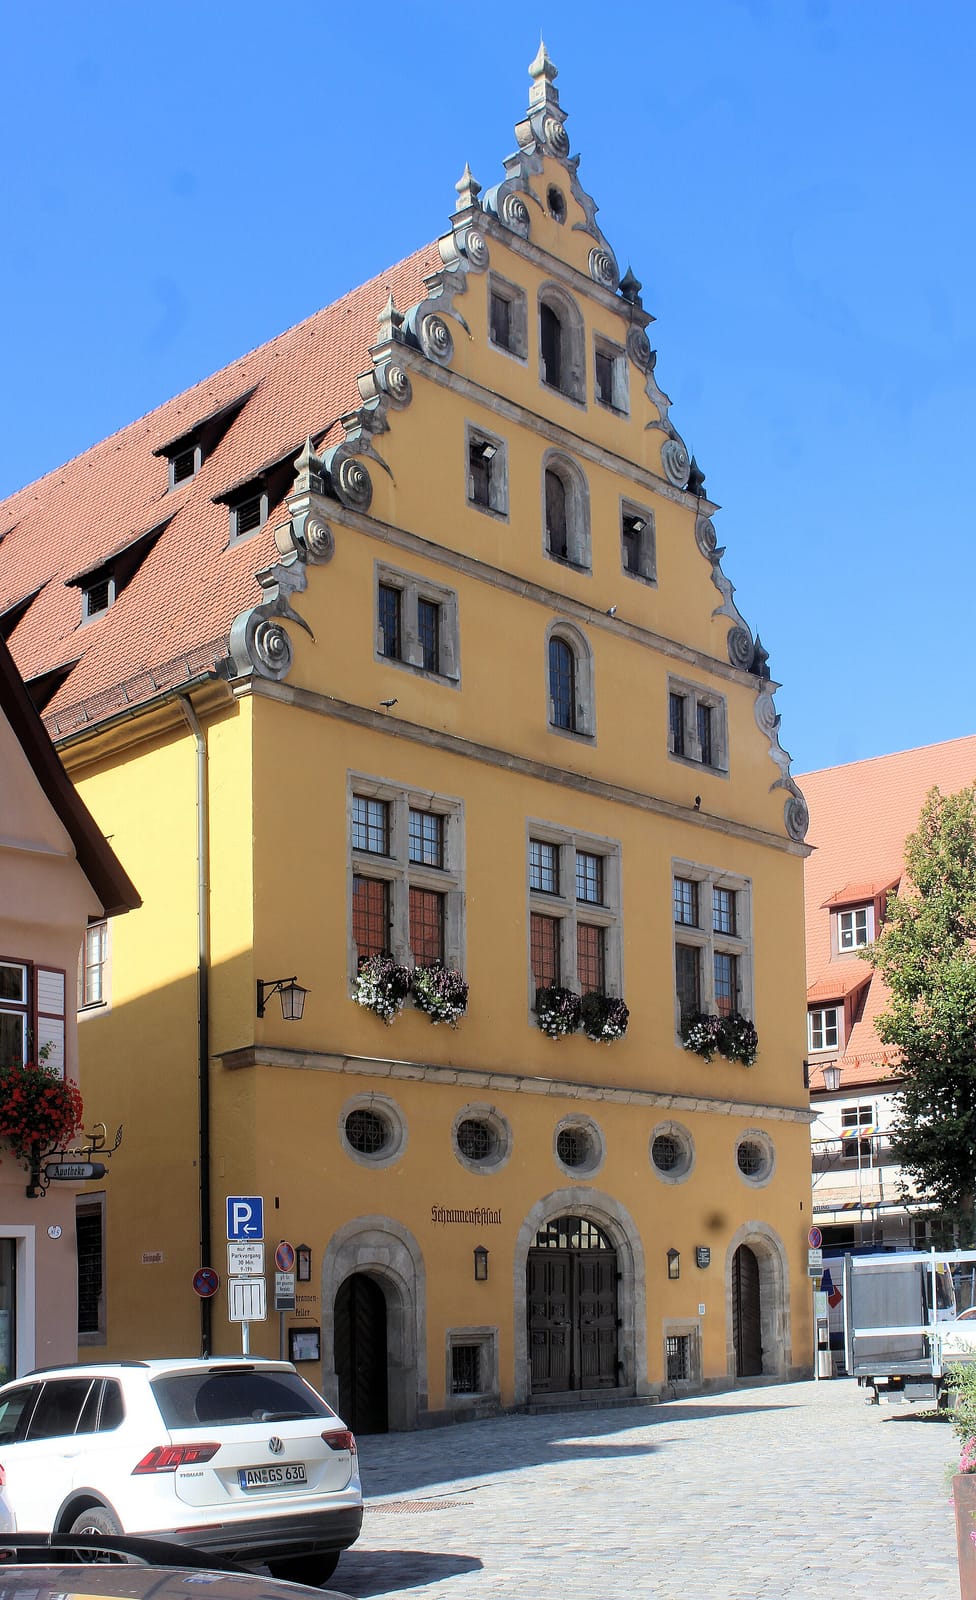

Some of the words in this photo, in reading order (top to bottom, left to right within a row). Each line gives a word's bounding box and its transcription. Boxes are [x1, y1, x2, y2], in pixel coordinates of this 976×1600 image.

[54, 1165, 85, 1177] Apotheke
[233, 1202, 253, 1235] P
[247, 1471, 263, 1485] AN
[268, 1468, 283, 1482] GS
[285, 1466, 305, 1480] 630
